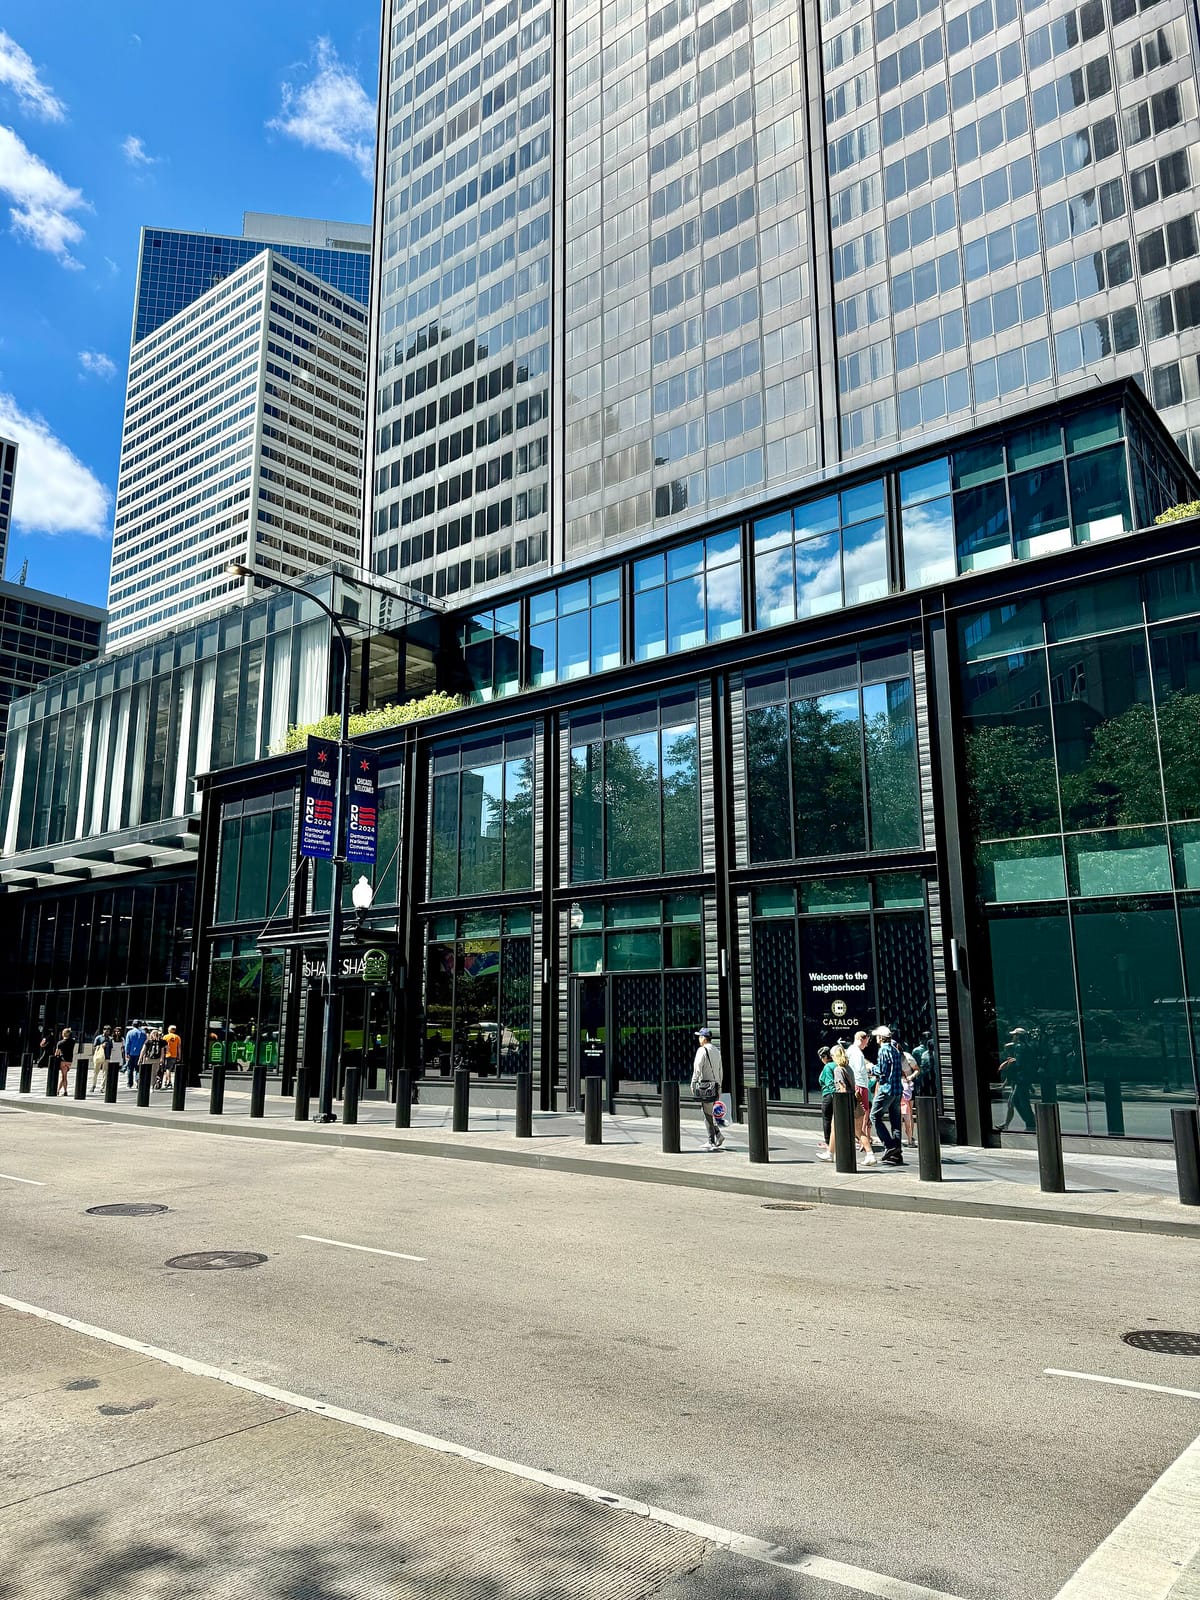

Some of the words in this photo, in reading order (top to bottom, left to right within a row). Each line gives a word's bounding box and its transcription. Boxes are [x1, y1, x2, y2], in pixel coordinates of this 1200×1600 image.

[313, 769, 329, 778] CHICAGO
[311, 776, 331, 786] WELCOMES
[356, 777, 372, 786] CHICAGO
[354, 784, 374, 793] WELCOMES
[314, 818, 332, 827] 2024
[305, 826, 331, 835] Democratic
[304, 837, 330, 846] Convention
[349, 833, 374, 841] Democratic
[808, 972, 844, 981] Welcome
[854, 972, 868, 980] the
[812, 983, 866, 993] neighborhood
